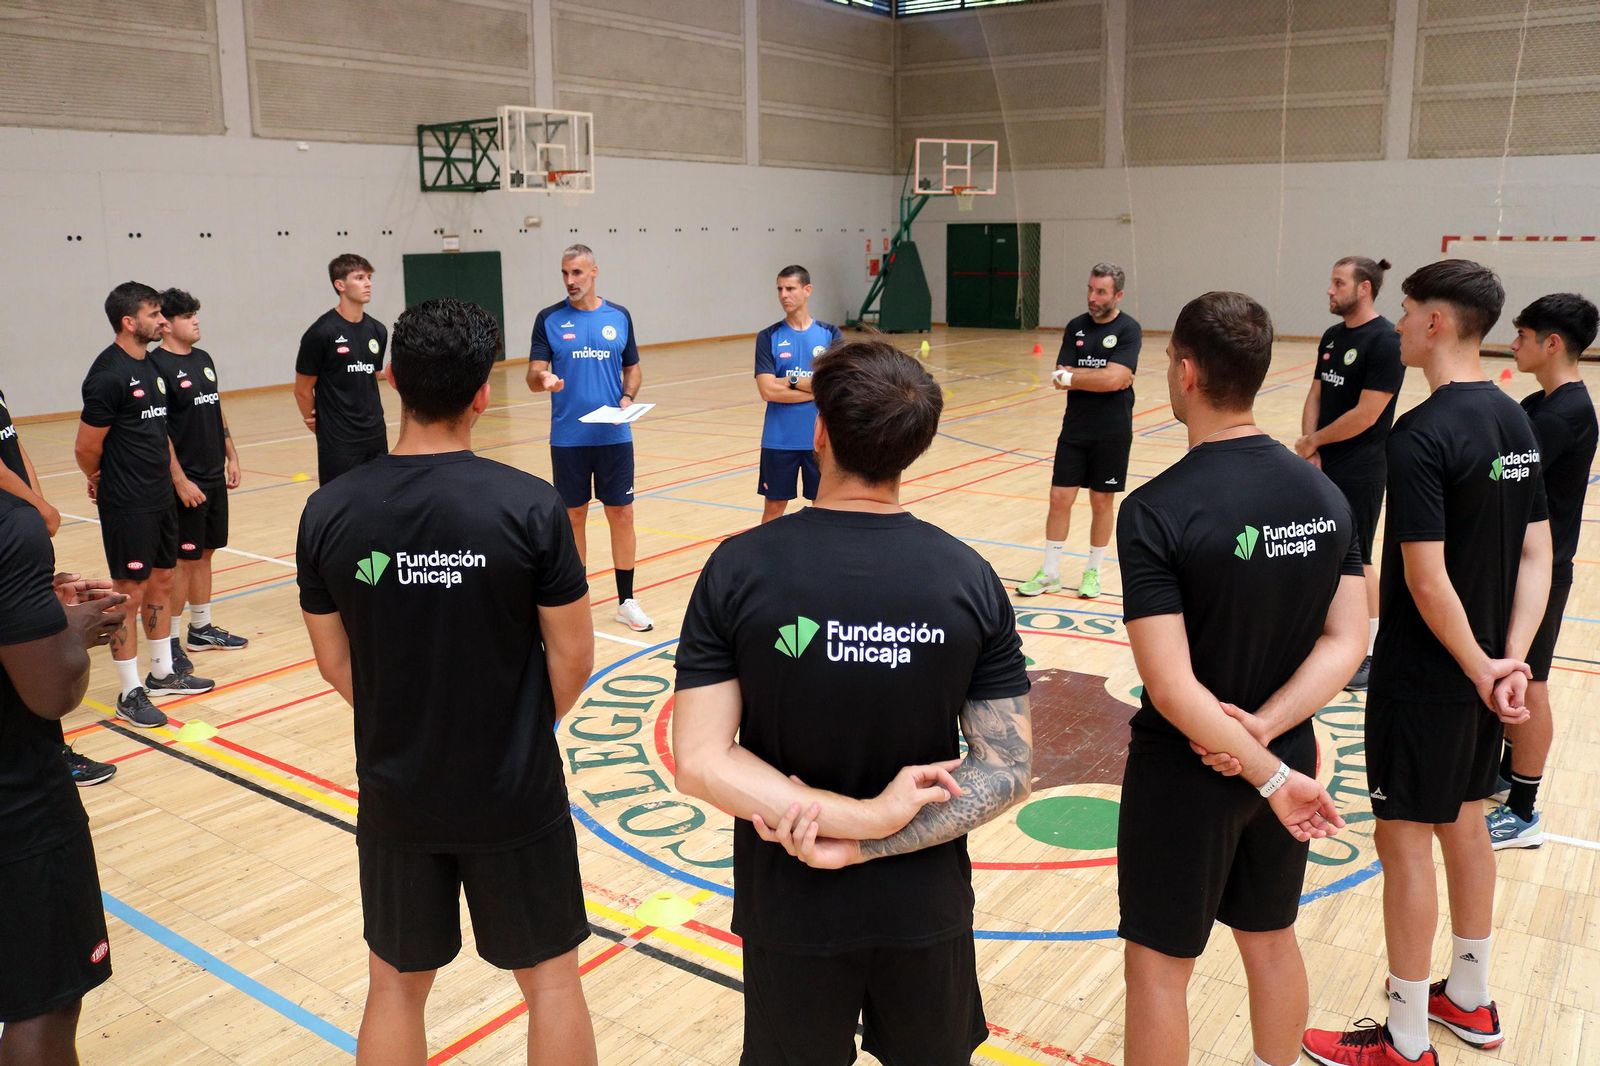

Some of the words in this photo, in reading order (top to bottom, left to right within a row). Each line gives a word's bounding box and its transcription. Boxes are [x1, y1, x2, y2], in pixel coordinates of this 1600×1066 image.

[1262, 517, 1337, 541] Fundación
[1265, 537, 1316, 558] Unicaja
[396, 550, 487, 568] Fundación
[398, 568, 462, 589] Unicaja
[827, 621, 945, 644] Fundación
[827, 641, 911, 669] Unicaja
